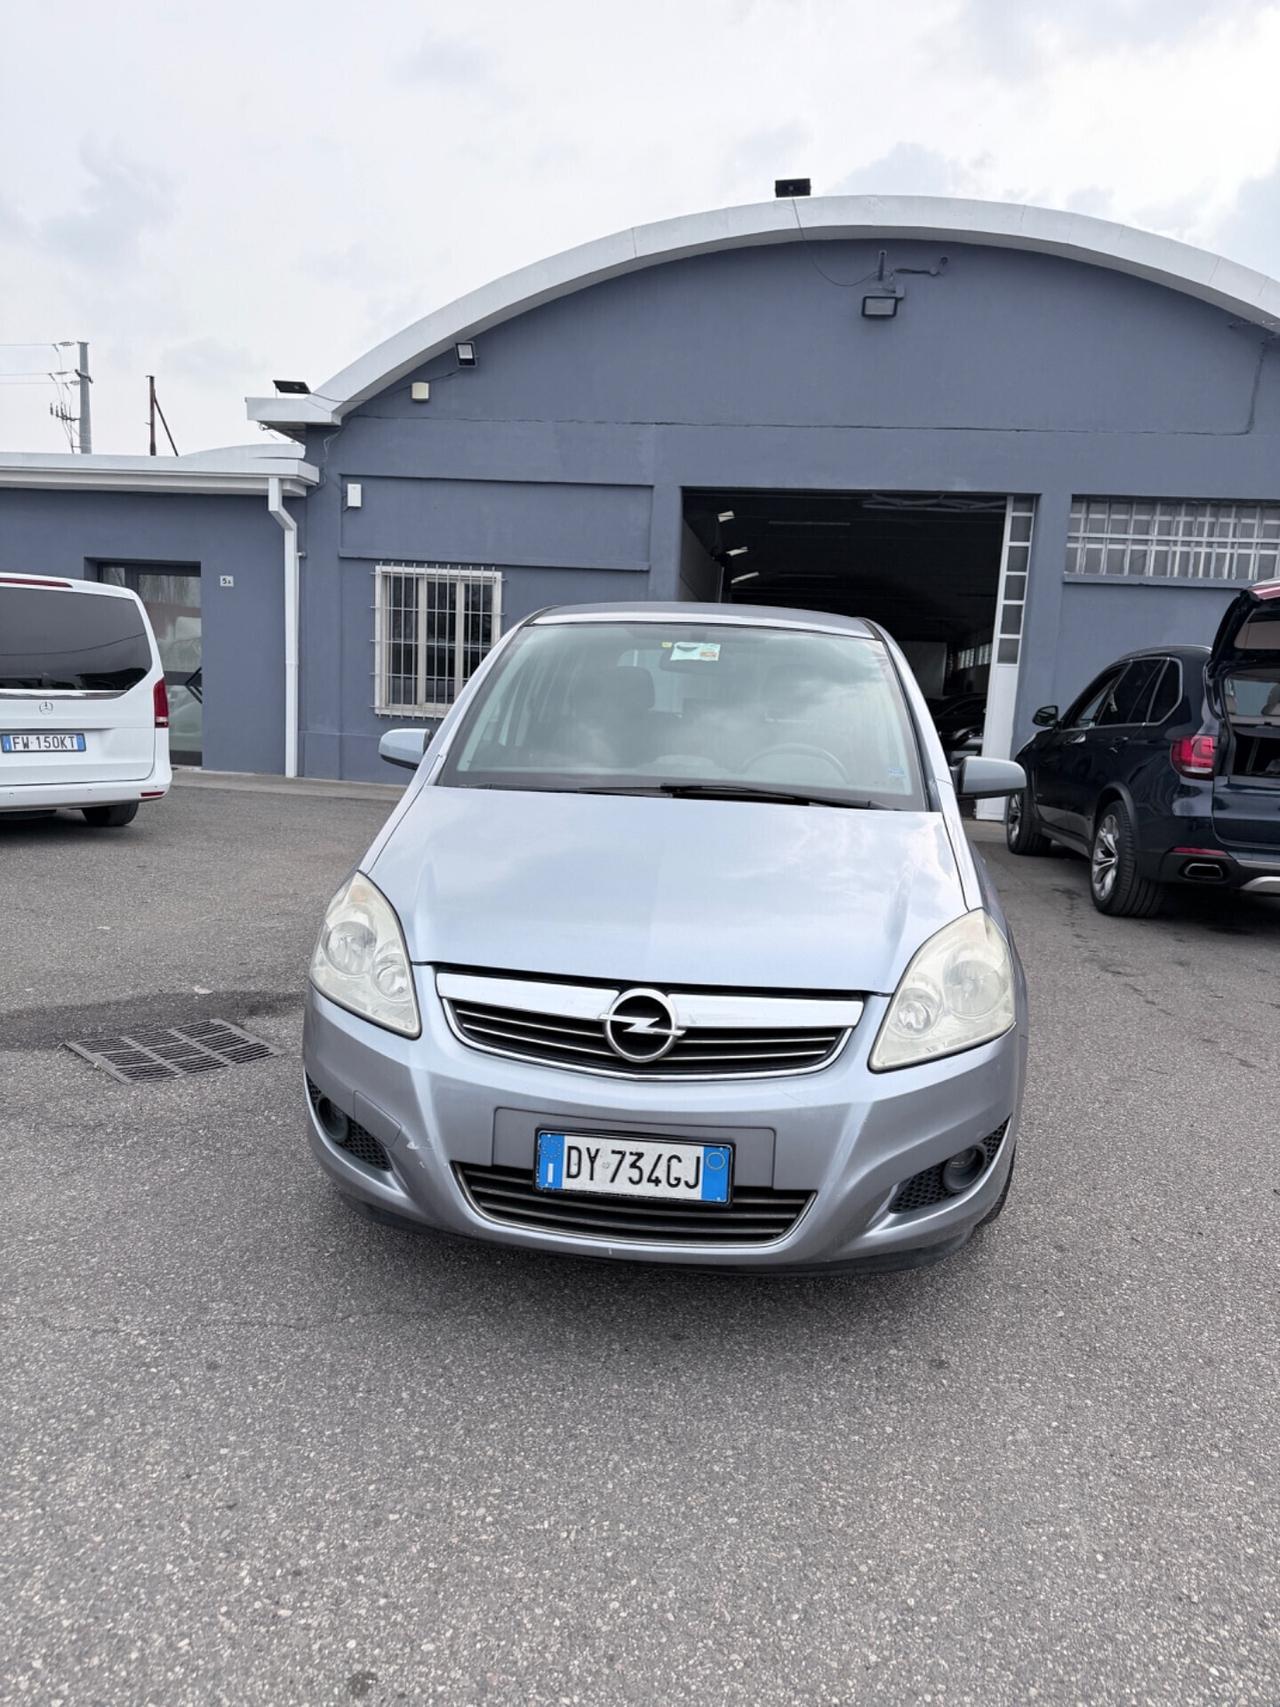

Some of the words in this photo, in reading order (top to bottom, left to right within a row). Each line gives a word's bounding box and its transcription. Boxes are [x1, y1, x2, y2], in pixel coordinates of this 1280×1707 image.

[12, 736, 30, 749] FW
[36, 736, 75, 749] 150KT
[566, 1145, 599, 1181] DY
[609, 1149, 700, 1189] 734GJ
